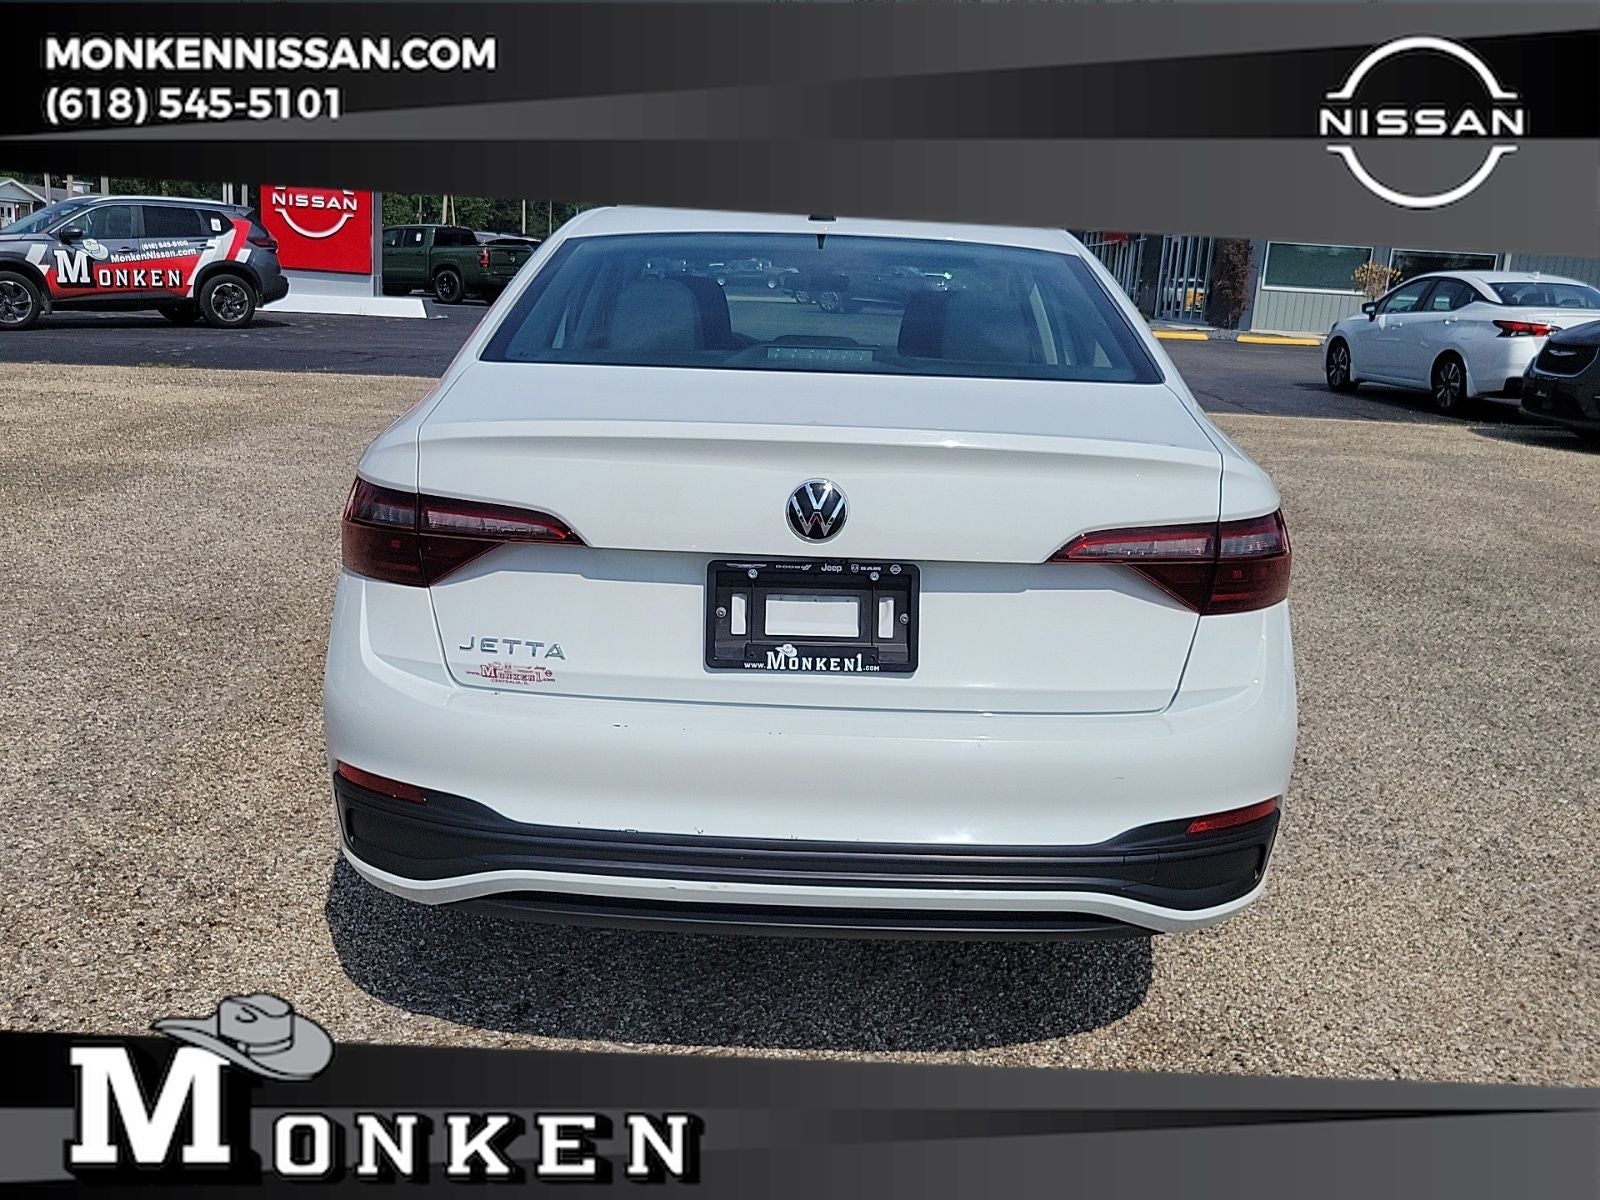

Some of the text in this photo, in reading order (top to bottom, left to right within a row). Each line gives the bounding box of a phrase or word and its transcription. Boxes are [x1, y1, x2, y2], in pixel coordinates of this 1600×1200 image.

[272, 191, 357, 211] NISSAN
[110, 248, 197, 263] MonkenNissan.com
[820, 560, 843, 573] Jeep
[459, 636, 566, 661] JETTA
